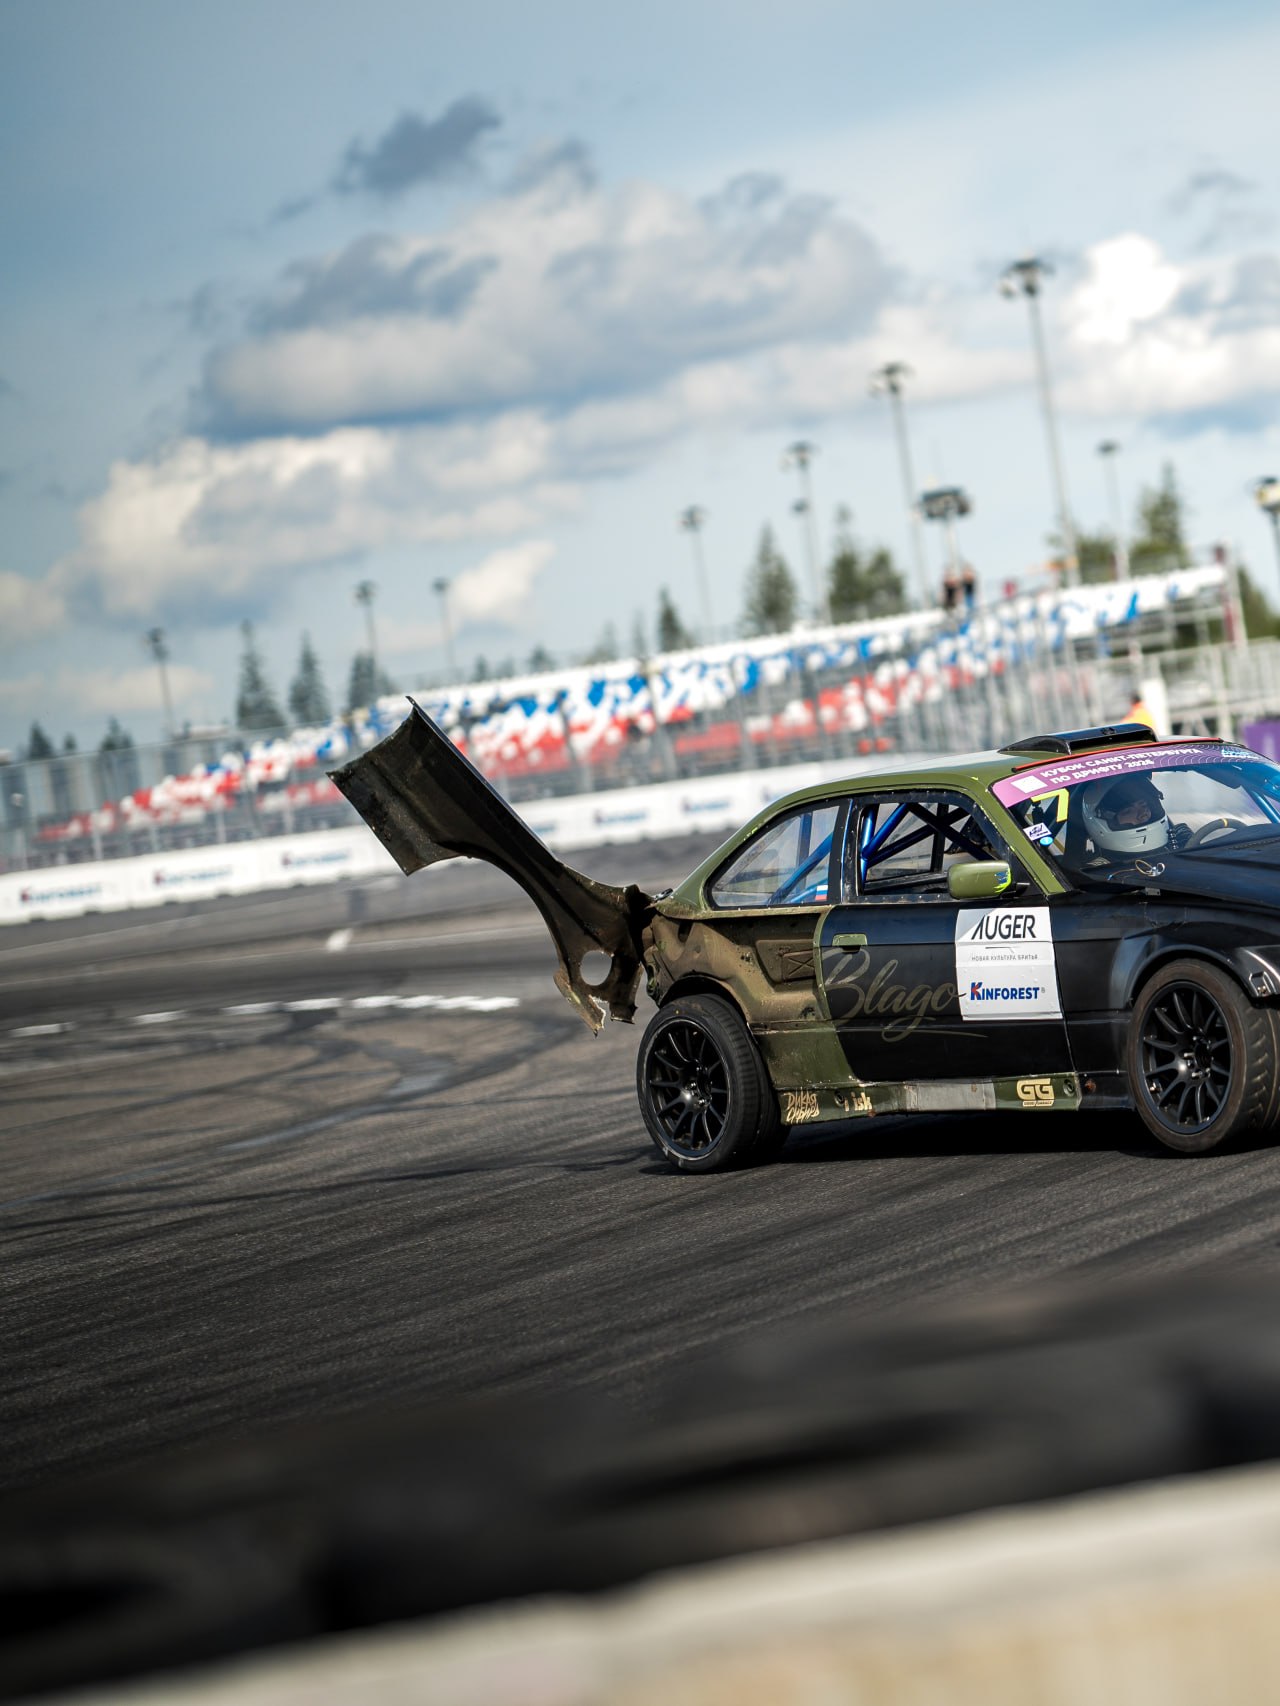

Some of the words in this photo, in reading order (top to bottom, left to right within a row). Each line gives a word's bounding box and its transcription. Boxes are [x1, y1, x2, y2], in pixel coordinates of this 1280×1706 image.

[1040, 763, 1086, 778] КУБОК
[1050, 775, 1072, 784] ПО
[1072, 763, 1123, 780] ДРИФТУ
[1030, 788, 1070, 823] 7
[971, 914, 1037, 940] AUGER
[822, 947, 988, 1042] Blago
[970, 981, 1040, 1001] KINFOREST
